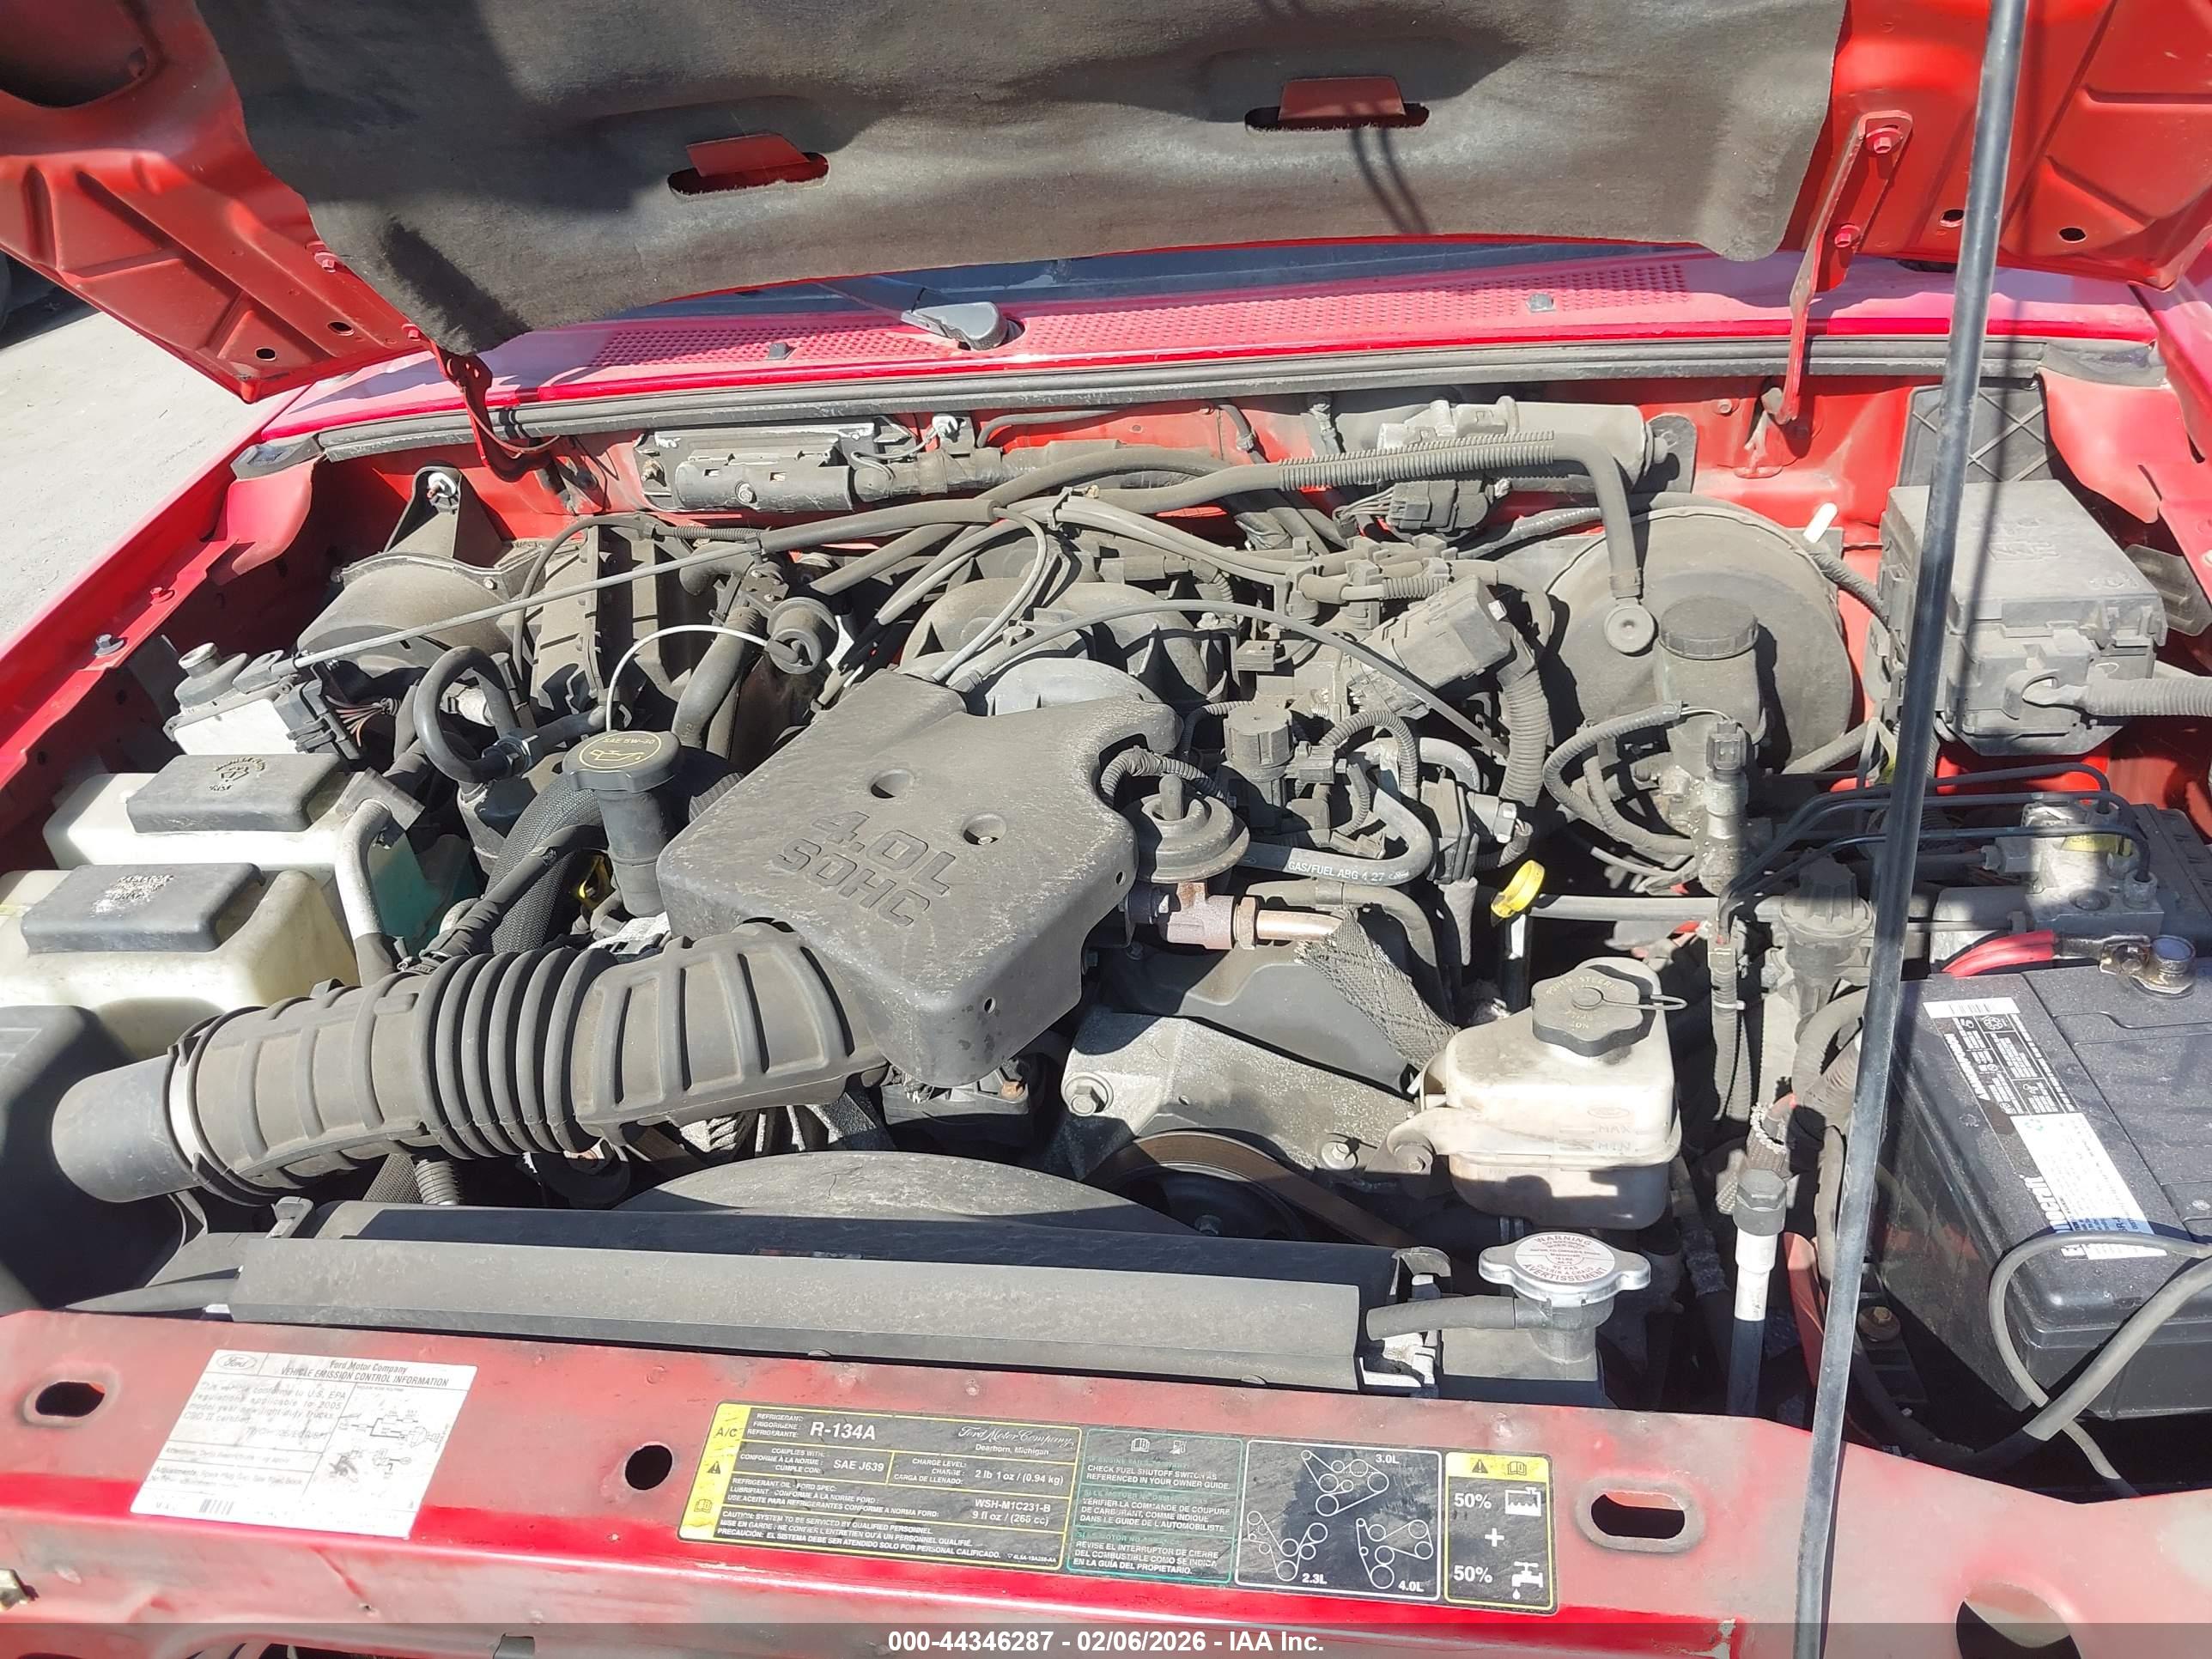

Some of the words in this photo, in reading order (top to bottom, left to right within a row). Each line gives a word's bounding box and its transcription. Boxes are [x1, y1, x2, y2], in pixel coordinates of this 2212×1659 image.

[811, 811, 957, 896] 4.0L
[1288, 861, 1334, 877] GAS/FUEL
[773, 838, 932, 928] SOHC
[1534, 1235, 1592, 1246] WARNING
[1522, 1264, 1607, 1281] AVERTISSEMENT
[223, 1356, 248, 1369] Ford
[329, 1360, 348, 1370] Ford
[349, 1362, 371, 1372] Motor
[373, 1364, 408, 1375] Company
[281, 1367, 313, 1378] VEHICLE
[314, 1370, 354, 1381] EMISSION
[356, 1372, 392, 1384] CONTROL
[393, 1375, 450, 1388] INFORMATION
[307, 1390, 325, 1399] U.S.
[328, 1391, 346, 1400] EPA
[715, 1427, 738, 1437] A/C
[810, 1421, 876, 1441] R-134A
[958, 1425, 984, 1437] Ford
[986, 1430, 1018, 1443] Motor
[771, 1448, 805, 1457] COMPLIES
[975, 1443, 1013, 1455] Dearborn,
[1014, 1446, 1049, 1456] Michigan
[740, 1454, 777, 1462] CONFORME
[834, 1459, 856, 1470] SAE
[859, 1462, 884, 1473] J639
[1375, 1453, 1400, 1465] 3.0L
[975, 1469, 981, 1479] 2
[983, 1469, 993, 1480] lb
[996, 1471, 1001, 1480] 1
[1022, 1472, 1046, 1485] (0.94
[1048, 1474, 1064, 1486] kg)
[1087, 1464, 1115, 1474] CHECK
[1115, 1467, 1136, 1475] FUEL
[1137, 1468, 1173, 1477] SHUTOFF
[732, 1477, 780, 1488] REFRIGERANT
[780, 1480, 791, 1489] OIL
[796, 1483, 816, 1492] FORD
[894, 1474, 917, 1482] CARGA
[929, 1476, 963, 1486] LLENADO:
[1086, 1473, 1138, 1484] REFERENCED
[1149, 1477, 1171, 1486] YOUR
[1173, 1479, 1202, 1488] OWNER
[1204, 1480, 1231, 1491] GUIDE.
[775, 1489, 811, 1499] CONFORME
[830, 1493, 855, 1503] NORME
[856, 1495, 876, 1504] FORD
[1454, 1492, 1492, 1510] 50%
[743, 1496, 766, 1504] ACEITE
[768, 1497, 786, 1505] PARA
[787, 1499, 842, 1510] REFRIGERANTES
[844, 1503, 884, 1513] CONFORME
[890, 1507, 915, 1517] NORMA
[917, 1510, 939, 1518] FORD:
[975, 1498, 1051, 1513] WSH-M1C231-B
[1082, 1497, 1118, 1507] VÉRIFIER
[1131, 1501, 1176, 1512] COMMANDE
[1179, 1504, 1190, 1513] DE
[1191, 1505, 1230, 1516] COUPURE
[972, 1510, 978, 1519] 9
[981, 1511, 988, 1521] fl
[1033, 1515, 1049, 1527] cc)
[1079, 1514, 1102, 1523] DANS
[1115, 1517, 1140, 1526] GUIDE
[1093, 1508, 1144, 1519] CARBURANT,
[1146, 1511, 1175, 1520] COMME
[756, 1512, 783, 1522] SYSTEM
[785, 1515, 793, 1523] TO
[805, 1517, 840, 1527] SERVICED
[852, 1522, 889, 1531] QUALIFIED
[890, 1524, 933, 1535] PERSONNEL.
[748, 1522, 772, 1530] GARDE
[788, 1525, 818, 1534] CONFIER
[895, 1534, 937, 1545] PERSONNEL
[718, 1528, 764, 1538] PRECAUCIÓN:
[777, 1533, 806, 1541] SISTEMA
[807, 1534, 827, 1543] DEBE
[843, 1538, 878, 1548] ATENDIDO
[880, 1541, 900, 1550] SOLO
[901, 1542, 915, 1551] POR
[917, 1544, 955, 1554] PERSONAL
[957, 1547, 1000, 1559] CALIFICADO.
[1076, 1540, 1104, 1550] REVISE
[1105, 1542, 1115, 1551] EL
[1117, 1543, 1174, 1556] INTERRUPTOR
[1176, 1547, 1188, 1556] DE
[1189, 1549, 1219, 1559] CIERRE
[1074, 1549, 1090, 1558] DEL
[1091, 1550, 1148, 1563] COMBUSTIBLE
[1150, 1555, 1175, 1565] COMO
[1189, 1558, 1218, 1567] INDICA
[1085, 1559, 1097, 1567] LA
[1097, 1559, 1118, 1569] GUÍA
[1119, 1561, 1135, 1570] DEL
[1136, 1562, 1193, 1575] PROPIETARIO.
[1453, 1565, 1493, 1584] 50%
[1302, 1572, 1328, 1585] 2.3L
[1398, 1580, 1425, 1593] 4.0L
